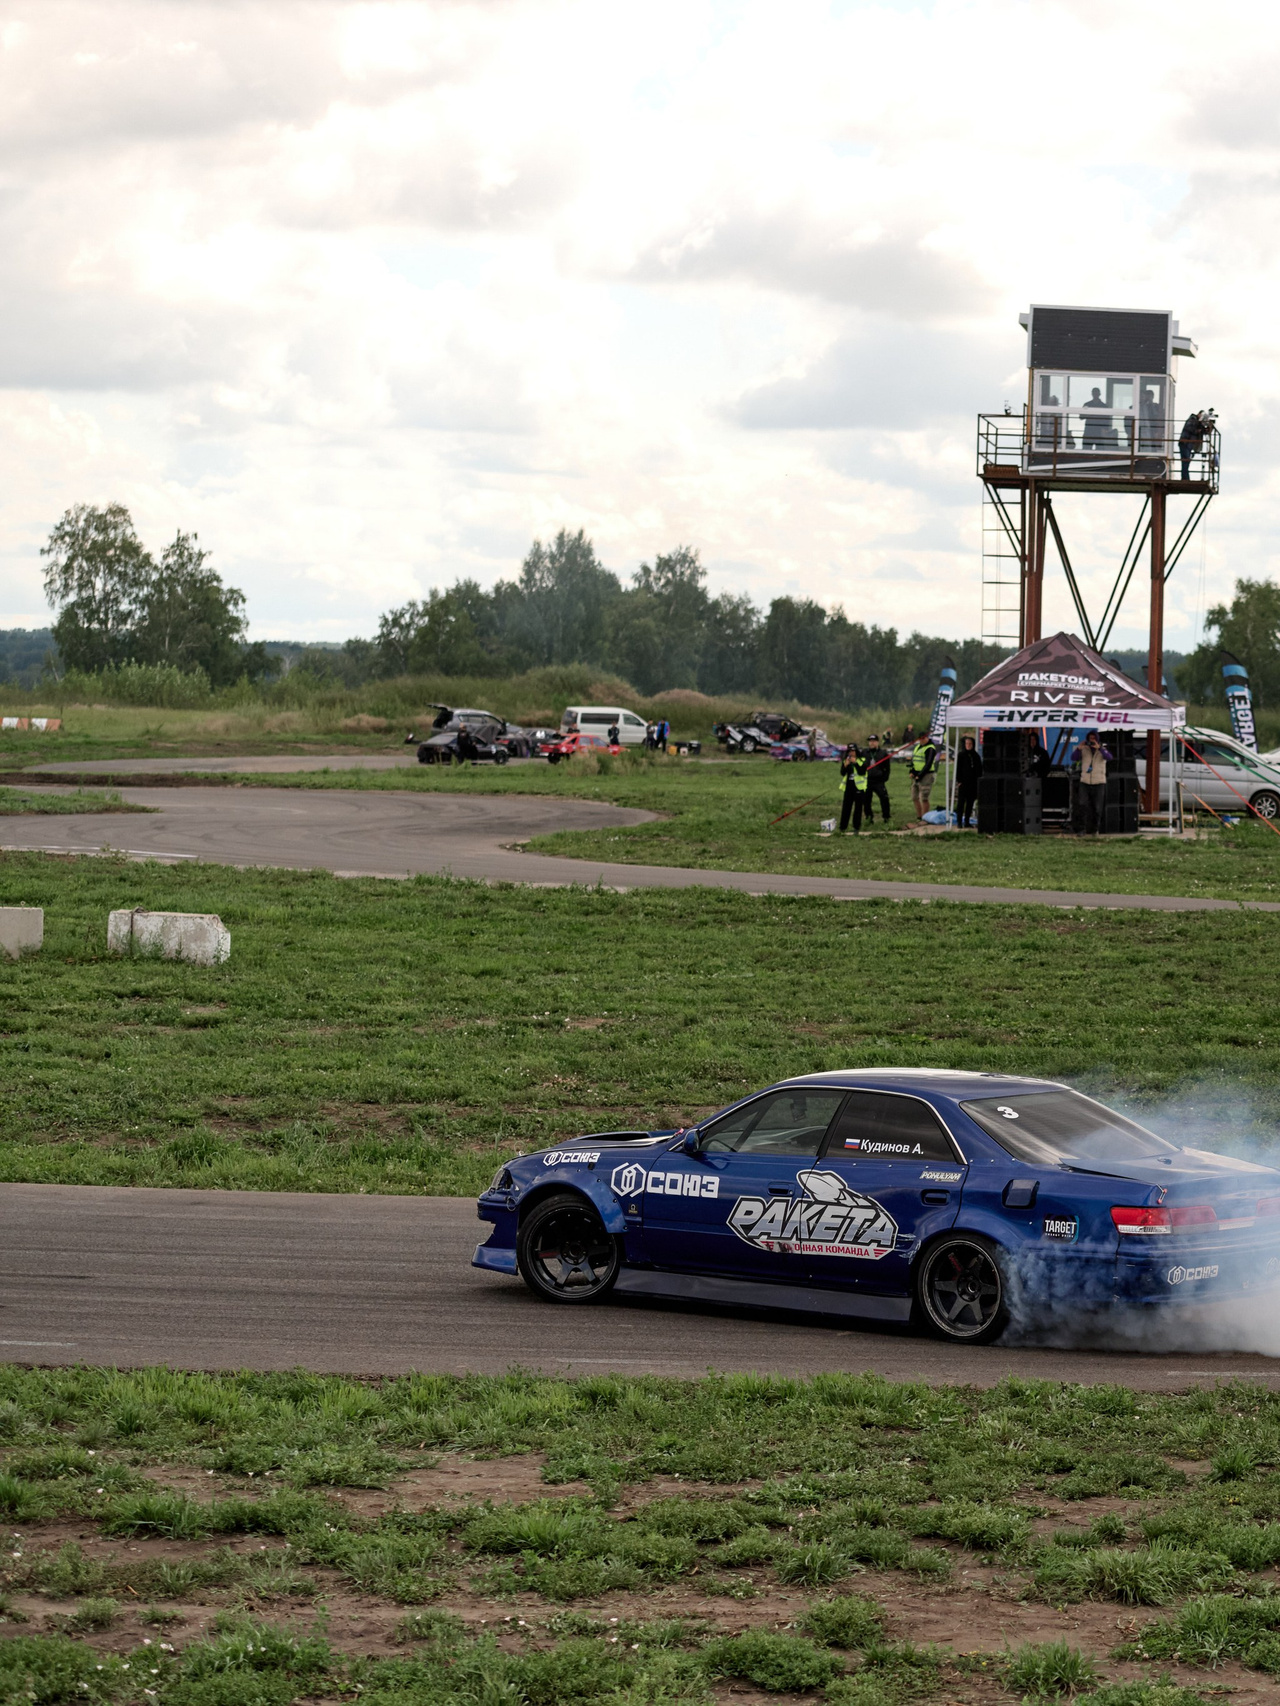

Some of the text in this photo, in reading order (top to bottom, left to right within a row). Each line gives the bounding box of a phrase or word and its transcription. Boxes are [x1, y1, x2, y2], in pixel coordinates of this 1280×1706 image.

[1010, 690, 1121, 706] RIVER
[994, 710, 1134, 724] HYPER FUEL
[997, 1106, 1019, 1119] 3
[860, 1139, 924, 1154] Кудинов А.
[561, 1152, 600, 1163] СОЮЗ
[646, 1171, 720, 1198] СОЮЗ
[731, 1200, 894, 1246] РАКЕТА
[1045, 1219, 1077, 1234] TARGET
[825, 1245, 870, 1257] КОМАНДА
[1185, 1265, 1219, 1281] СОЮЗ
